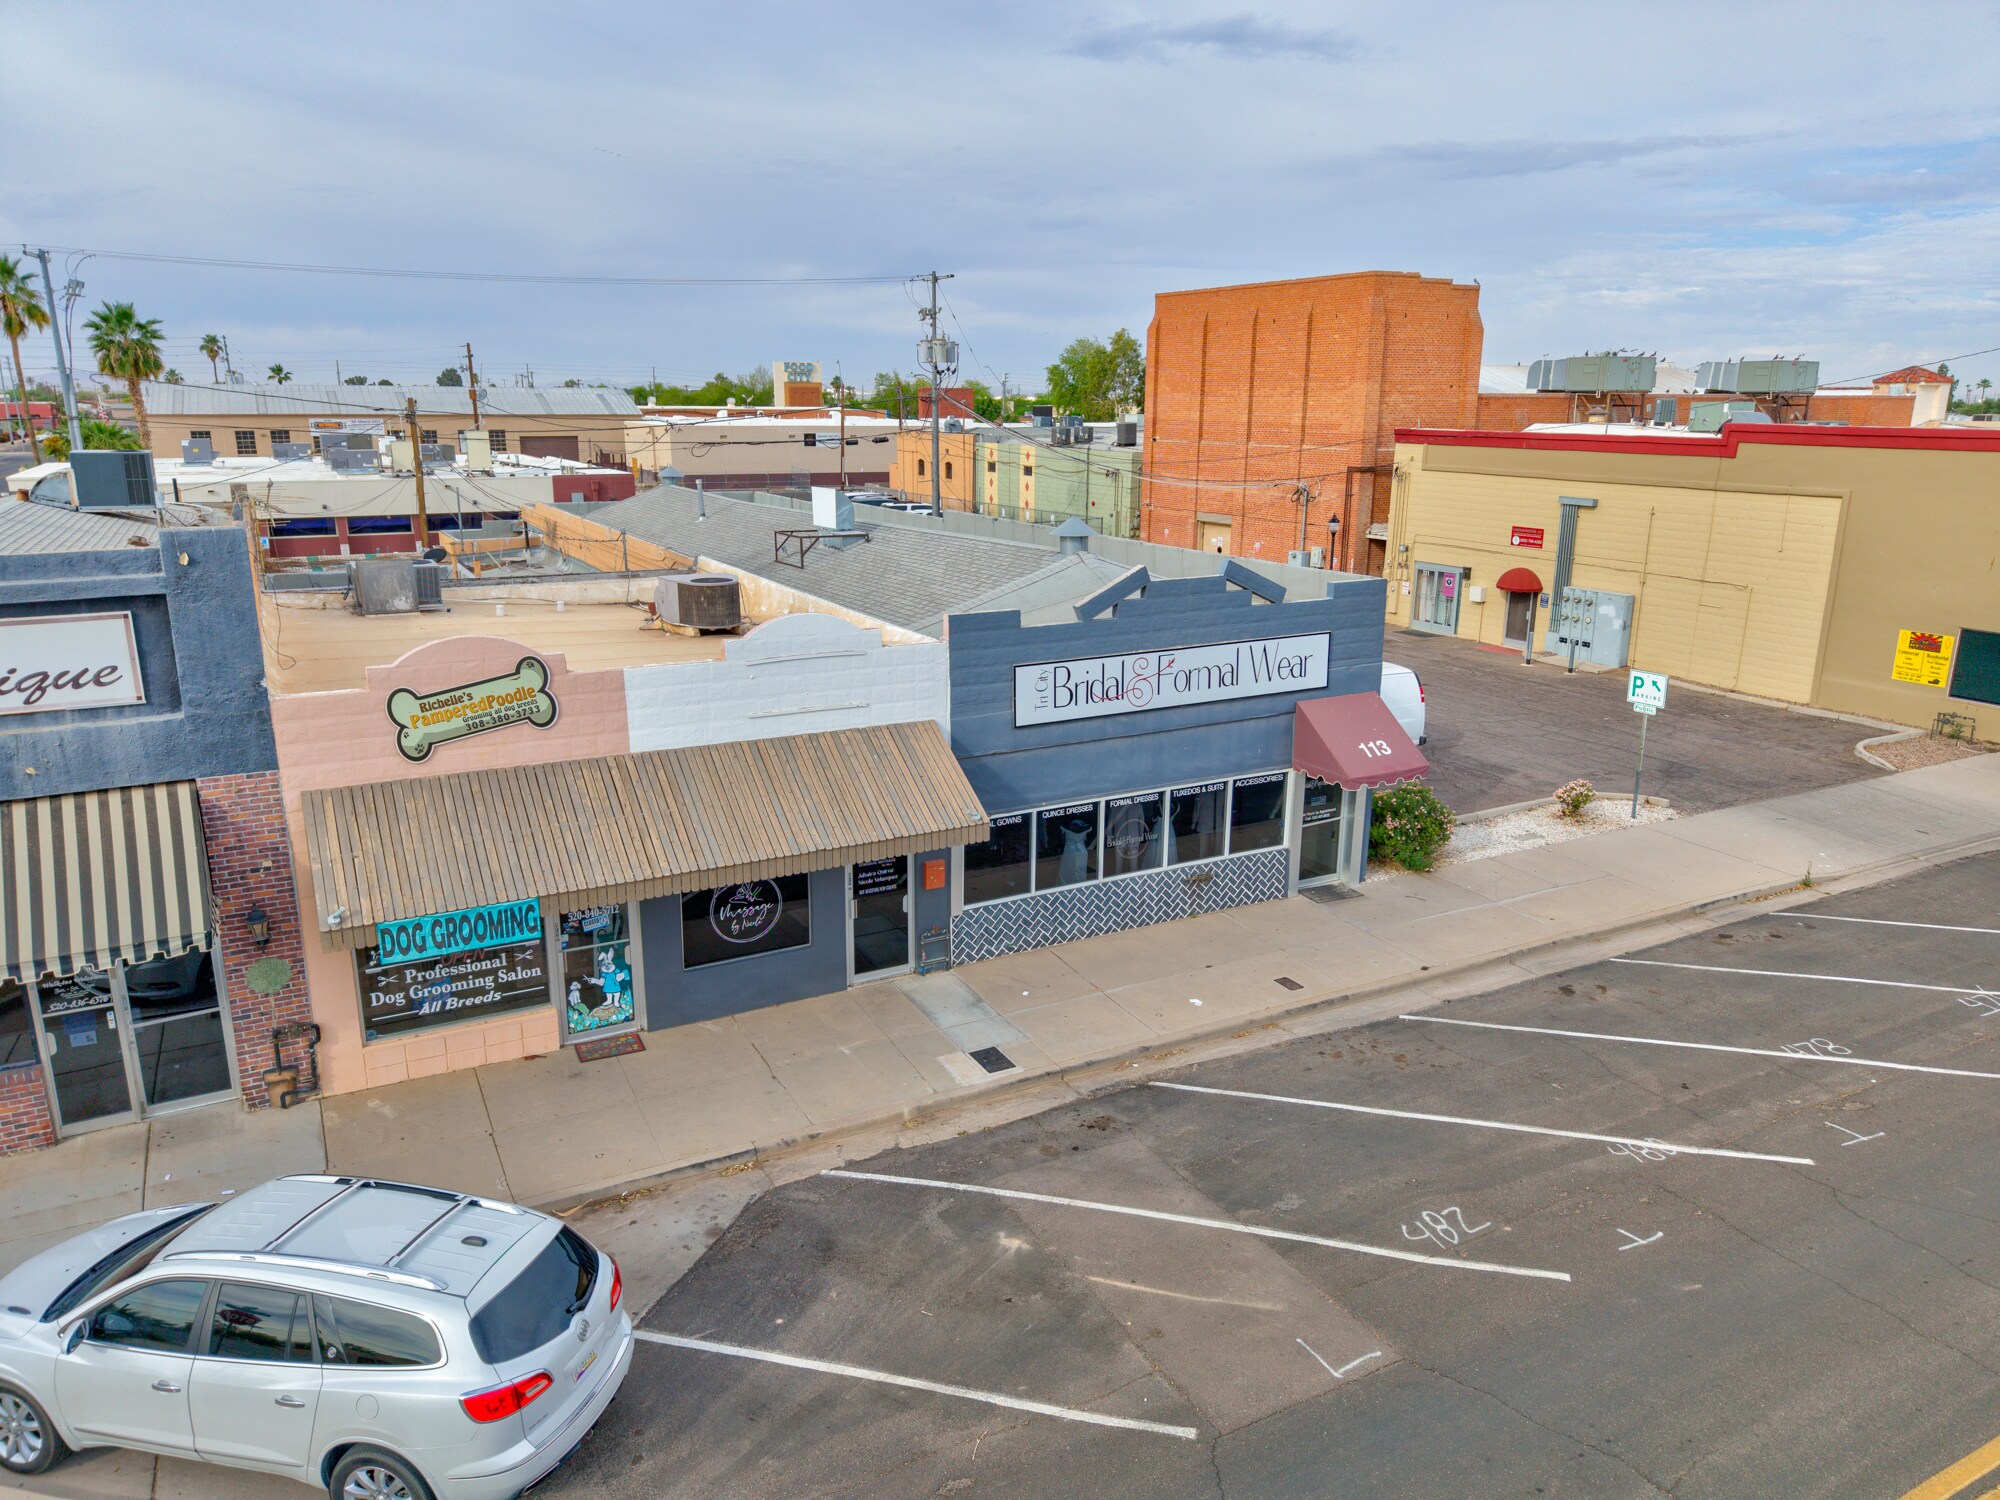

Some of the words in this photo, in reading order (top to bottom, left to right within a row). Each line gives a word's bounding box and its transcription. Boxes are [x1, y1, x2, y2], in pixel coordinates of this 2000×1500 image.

[784, 362, 814, 372] FOOD
[787, 372, 811, 382] CITY
[1034, 668, 1052, 692] City
[1053, 659, 1125, 709] Bridal
[1157, 646, 1239, 696] Formal
[1249, 641, 1314, 684] Wear
[462, 710, 493, 723] Grooming
[494, 707, 503, 715] all
[504, 703, 516, 712] dog
[517, 698, 538, 709] breeds
[1034, 695, 1049, 712] Tri
[1635, 704, 1654, 713] Public
[465, 704, 541, 731] 308-380-3733
[1358, 740, 1392, 758] 113
[1235, 774, 1284, 787] ACCESSORIES
[1172, 787, 1200, 797] TUXEDOS
[1207, 783, 1224, 792] SUITS
[1110, 797, 1133, 808] FORMAL
[1134, 793, 1159, 804] DRESSES
[1042, 808, 1065, 819] QUINCE
[1066, 804, 1094, 815] DRESSES
[997, 815, 1022, 827] GOWNS
[567, 904, 620, 922] 520-840-5712
[720, 902, 774, 920] Massage
[379, 922, 427, 959] DOG
[431, 904, 539, 950] GROOMING
[440, 948, 486, 967] OPEN
[404, 952, 507, 984] Professional
[370, 990, 406, 1007] Dog
[409, 975, 495, 999] Grooming
[498, 965, 542, 984] Salon
[418, 1000, 442, 1017] All
[445, 990, 502, 1010] Breeds
[1401, 1206, 1491, 1250] 482
